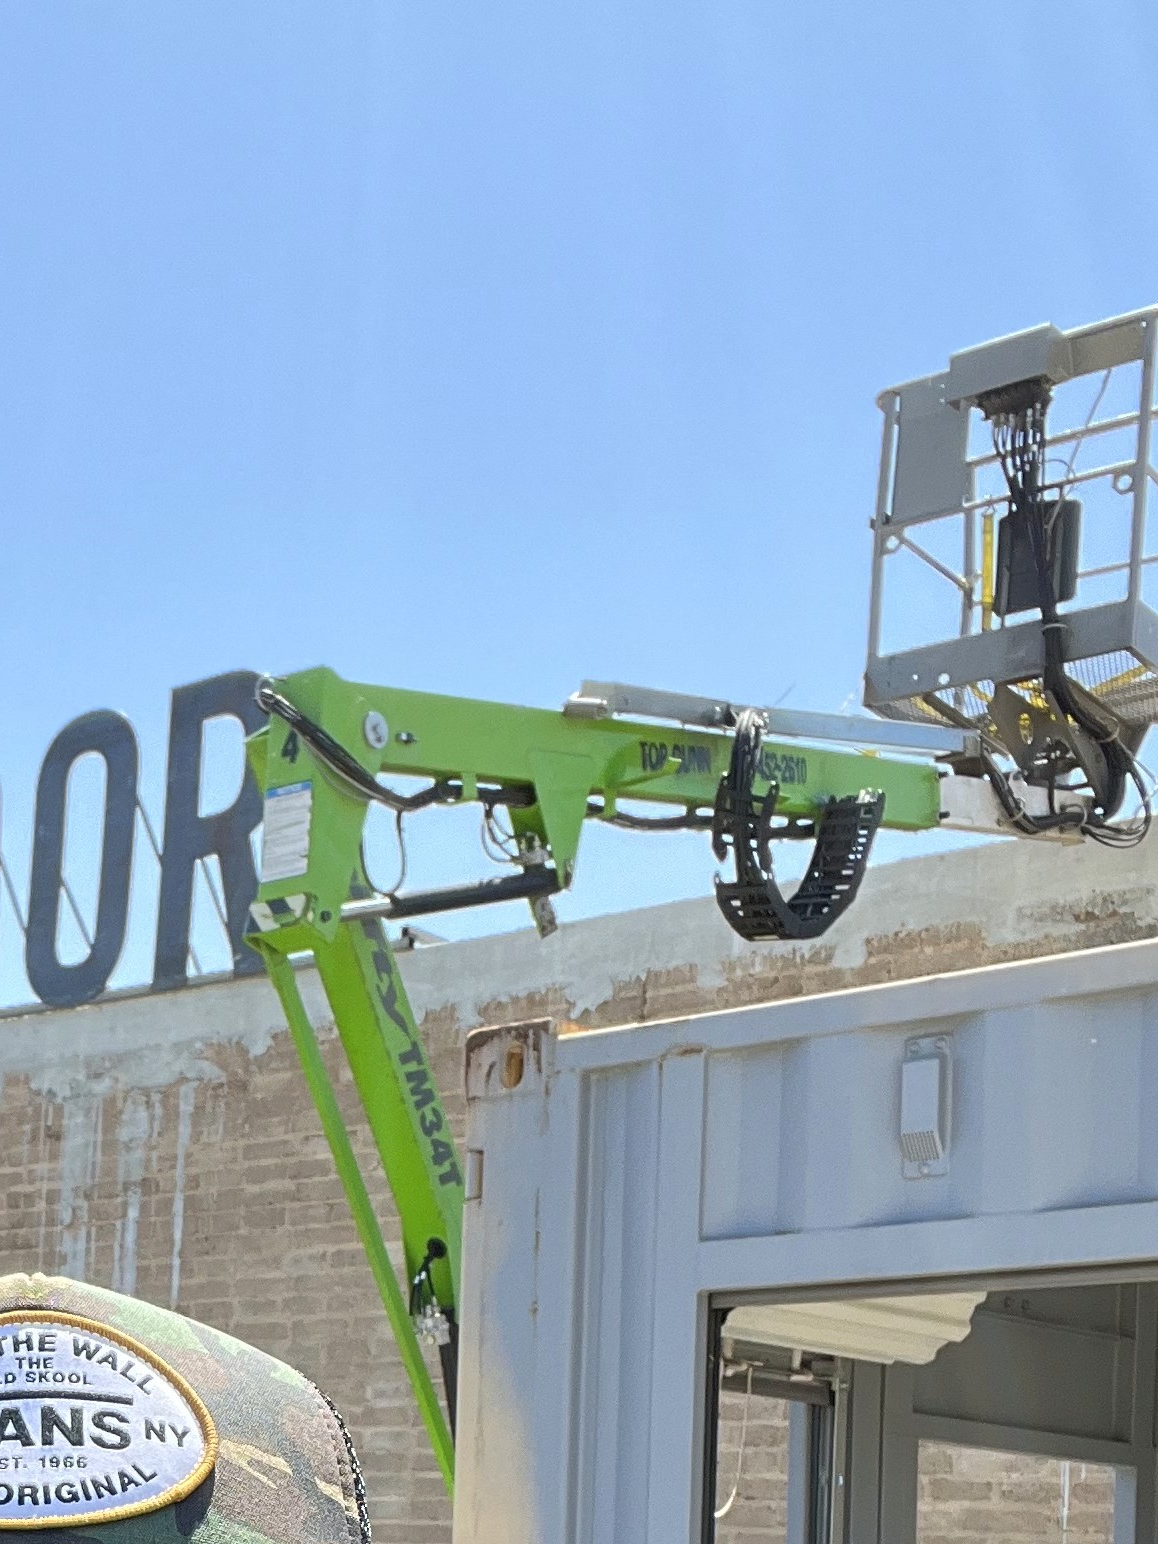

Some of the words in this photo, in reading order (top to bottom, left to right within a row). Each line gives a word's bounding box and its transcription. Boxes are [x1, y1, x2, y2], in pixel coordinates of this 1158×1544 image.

[281, 728, 299, 764] 4
[398, 1040, 463, 1187] TM34T
[15, 1357, 53, 1370] THE
[25, 1372, 94, 1386] SKOOL
[73, 1336, 156, 1395] WALL
[145, 1417, 191, 1448] NY
[39, 1456, 88, 1470] 1966
